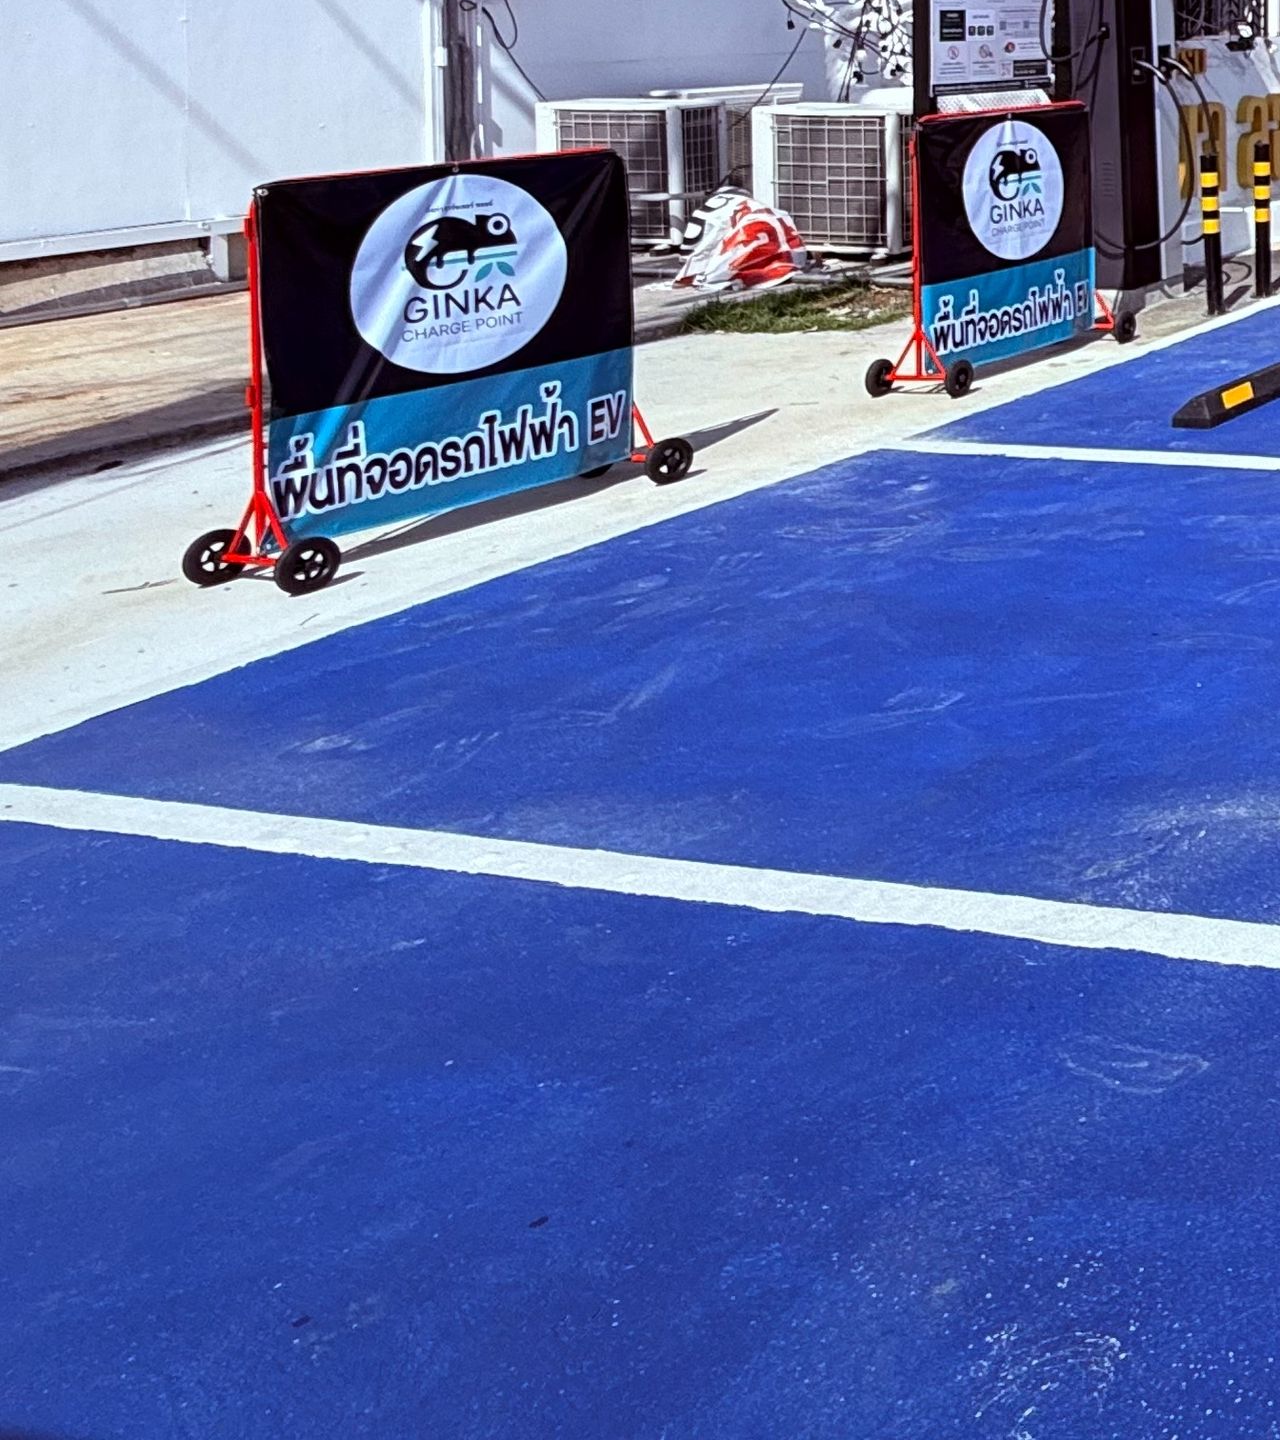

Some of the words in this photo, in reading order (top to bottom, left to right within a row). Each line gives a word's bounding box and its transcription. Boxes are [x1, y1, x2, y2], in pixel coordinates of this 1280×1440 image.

[990, 197, 1045, 225] GINKA
[403, 283, 522, 324] GINKA
[931, 269, 1074, 355] พื้นที่จอดรถไฟฟ้า
[401, 320, 471, 343] CHARGE
[475, 311, 523, 329] POINT
[271, 383, 578, 519] พื้นที่จอดรถไฟฟ้า
[589, 391, 626, 445] EV
